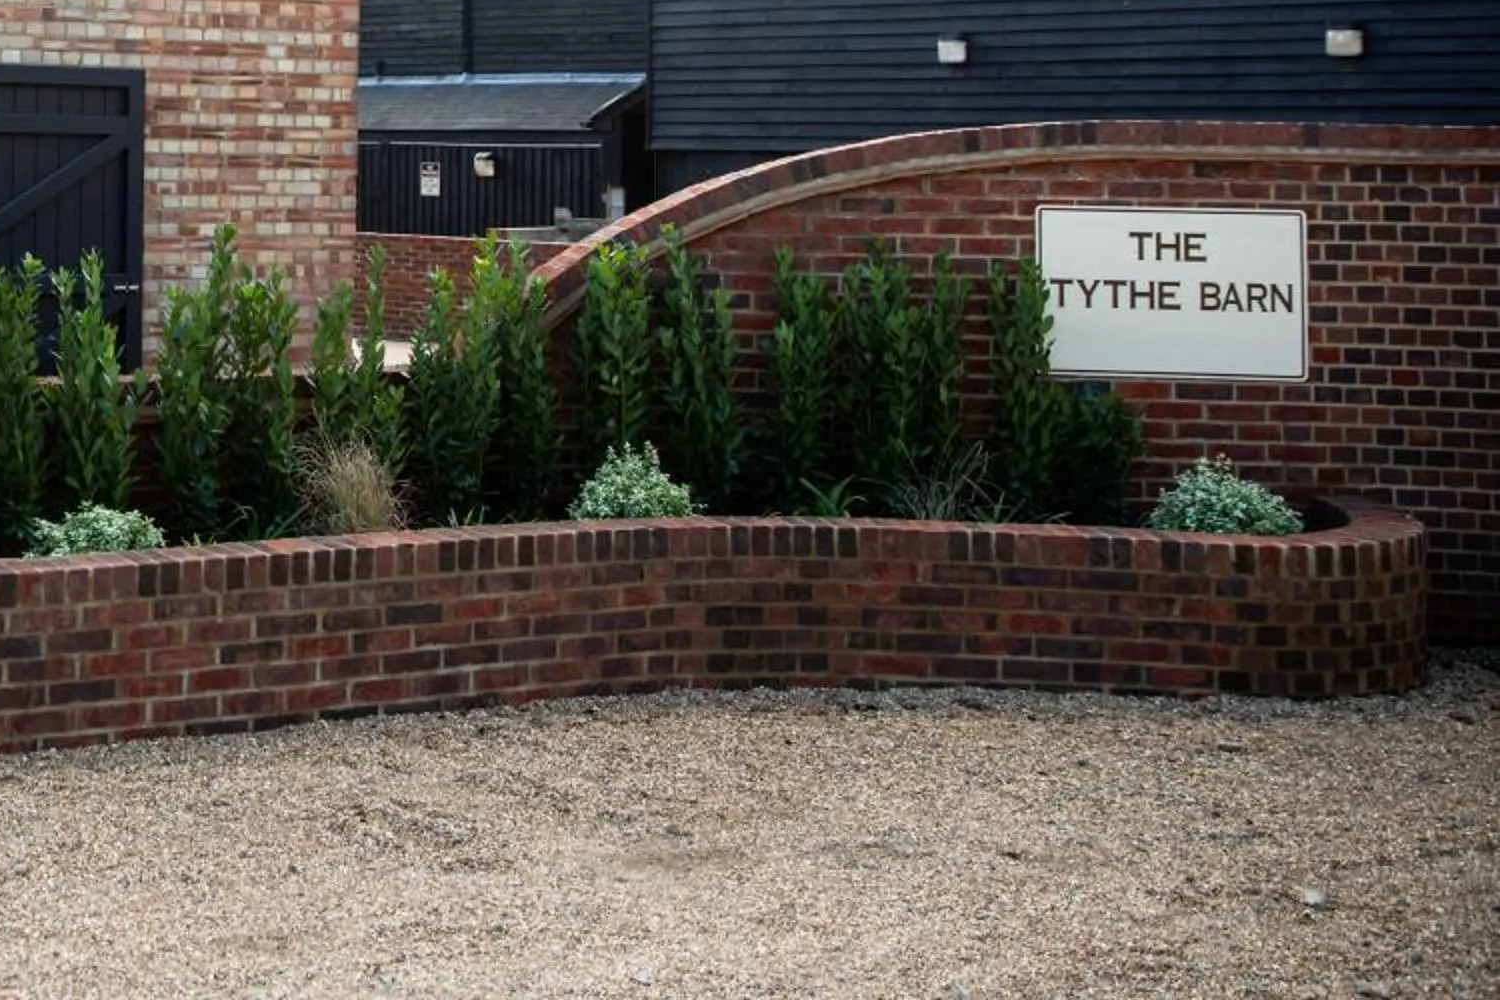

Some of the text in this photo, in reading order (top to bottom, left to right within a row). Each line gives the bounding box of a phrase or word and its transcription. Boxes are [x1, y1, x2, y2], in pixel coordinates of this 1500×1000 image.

[1128, 231, 1207, 262] THE
[1049, 278, 1294, 313] TYTHE BARN
